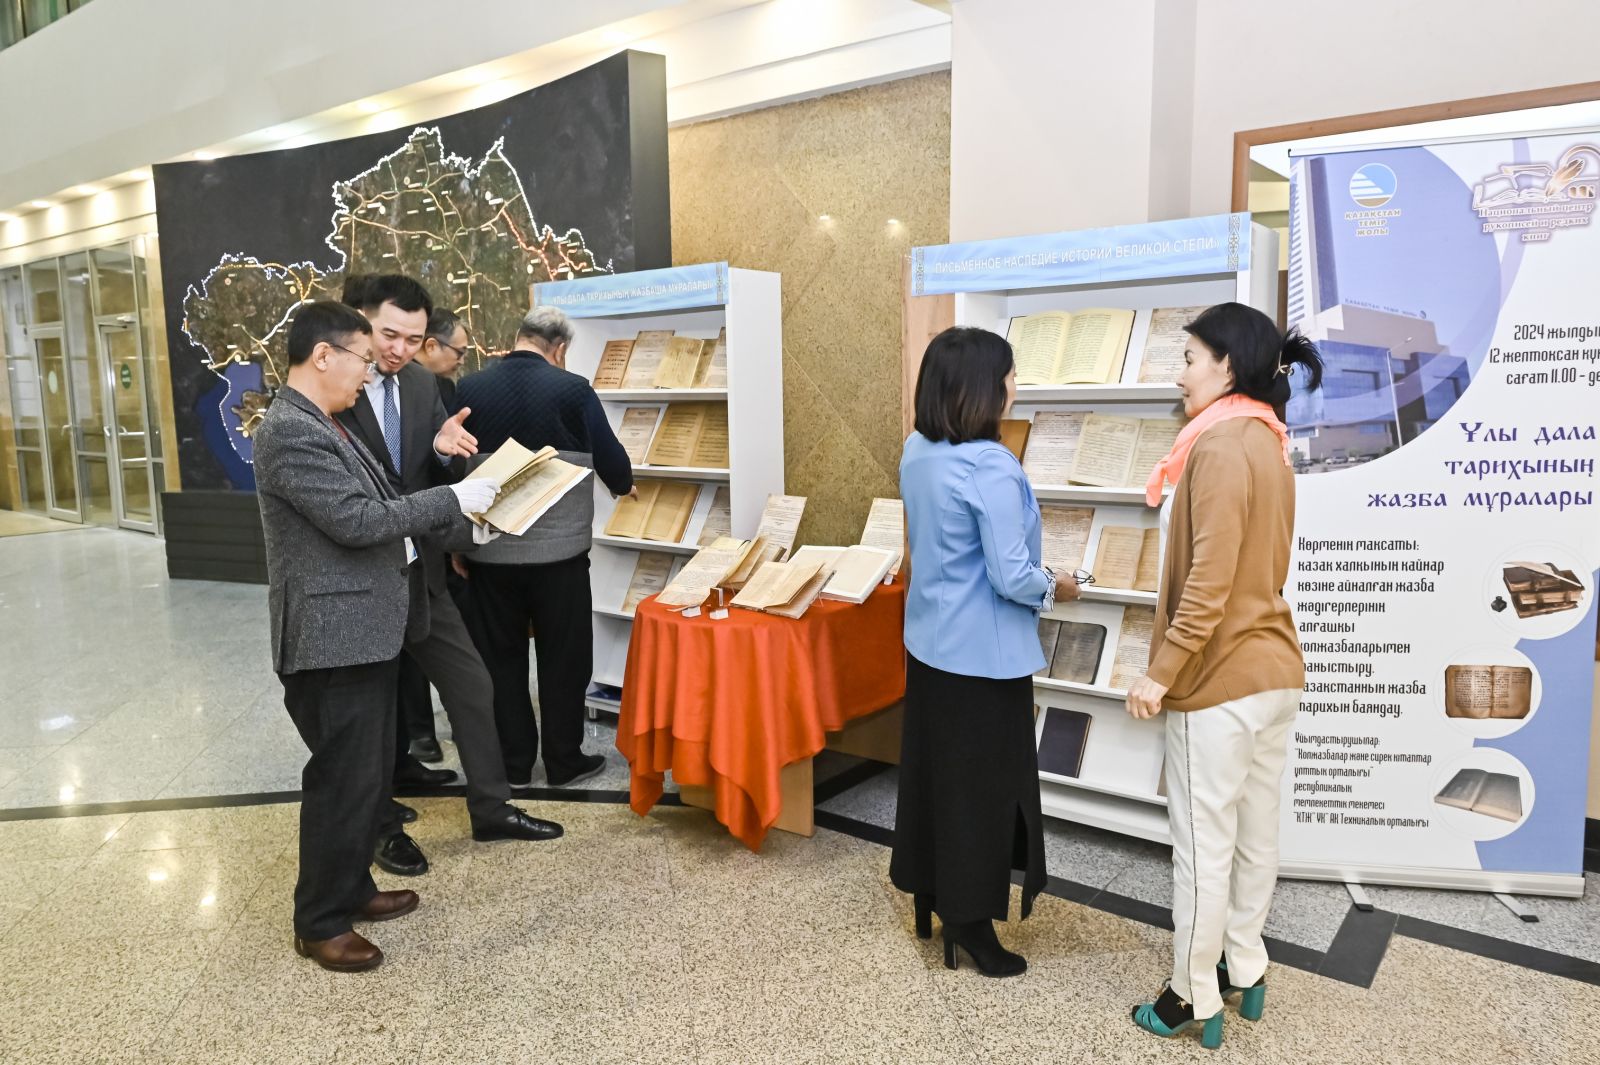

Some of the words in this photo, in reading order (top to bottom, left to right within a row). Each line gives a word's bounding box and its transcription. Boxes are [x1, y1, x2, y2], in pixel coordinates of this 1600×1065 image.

[1359, 219, 1386, 227] ТЕМІР
[1357, 228, 1388, 236] ЖОЛЫ
[1004, 252, 1058, 268] НАСЛЕДИЕ
[1061, 247, 1112, 263] ИСТОРИИ
[1514, 324, 1544, 341] 2024
[1547, 326, 1600, 343] жылды
[1489, 347, 1500, 364] 12
[1551, 367, 1577, 383] 11.00
[1459, 422, 1517, 442] Ұлы
[1534, 426, 1596, 446] дала
[1444, 459, 1594, 480] тарихының
[1367, 493, 1448, 508] жазба
[1463, 491, 1593, 513] мұралары
[1297, 581, 1335, 592] көзіне
[1395, 578, 1435, 593] жазба
[1300, 639, 1411, 657] олжазбаларымен
[1303, 662, 1375, 677] аныстыру.
[1387, 680, 1426, 695] жазба
[1352, 699, 1403, 718] баяндау.
[1349, 752, 1369, 761] және
[1370, 753, 1392, 765] сирек
[1393, 754, 1432, 766] кітаптар
[1293, 798, 1347, 808] мемлекеттік
[1348, 799, 1385, 810] мекемесі
